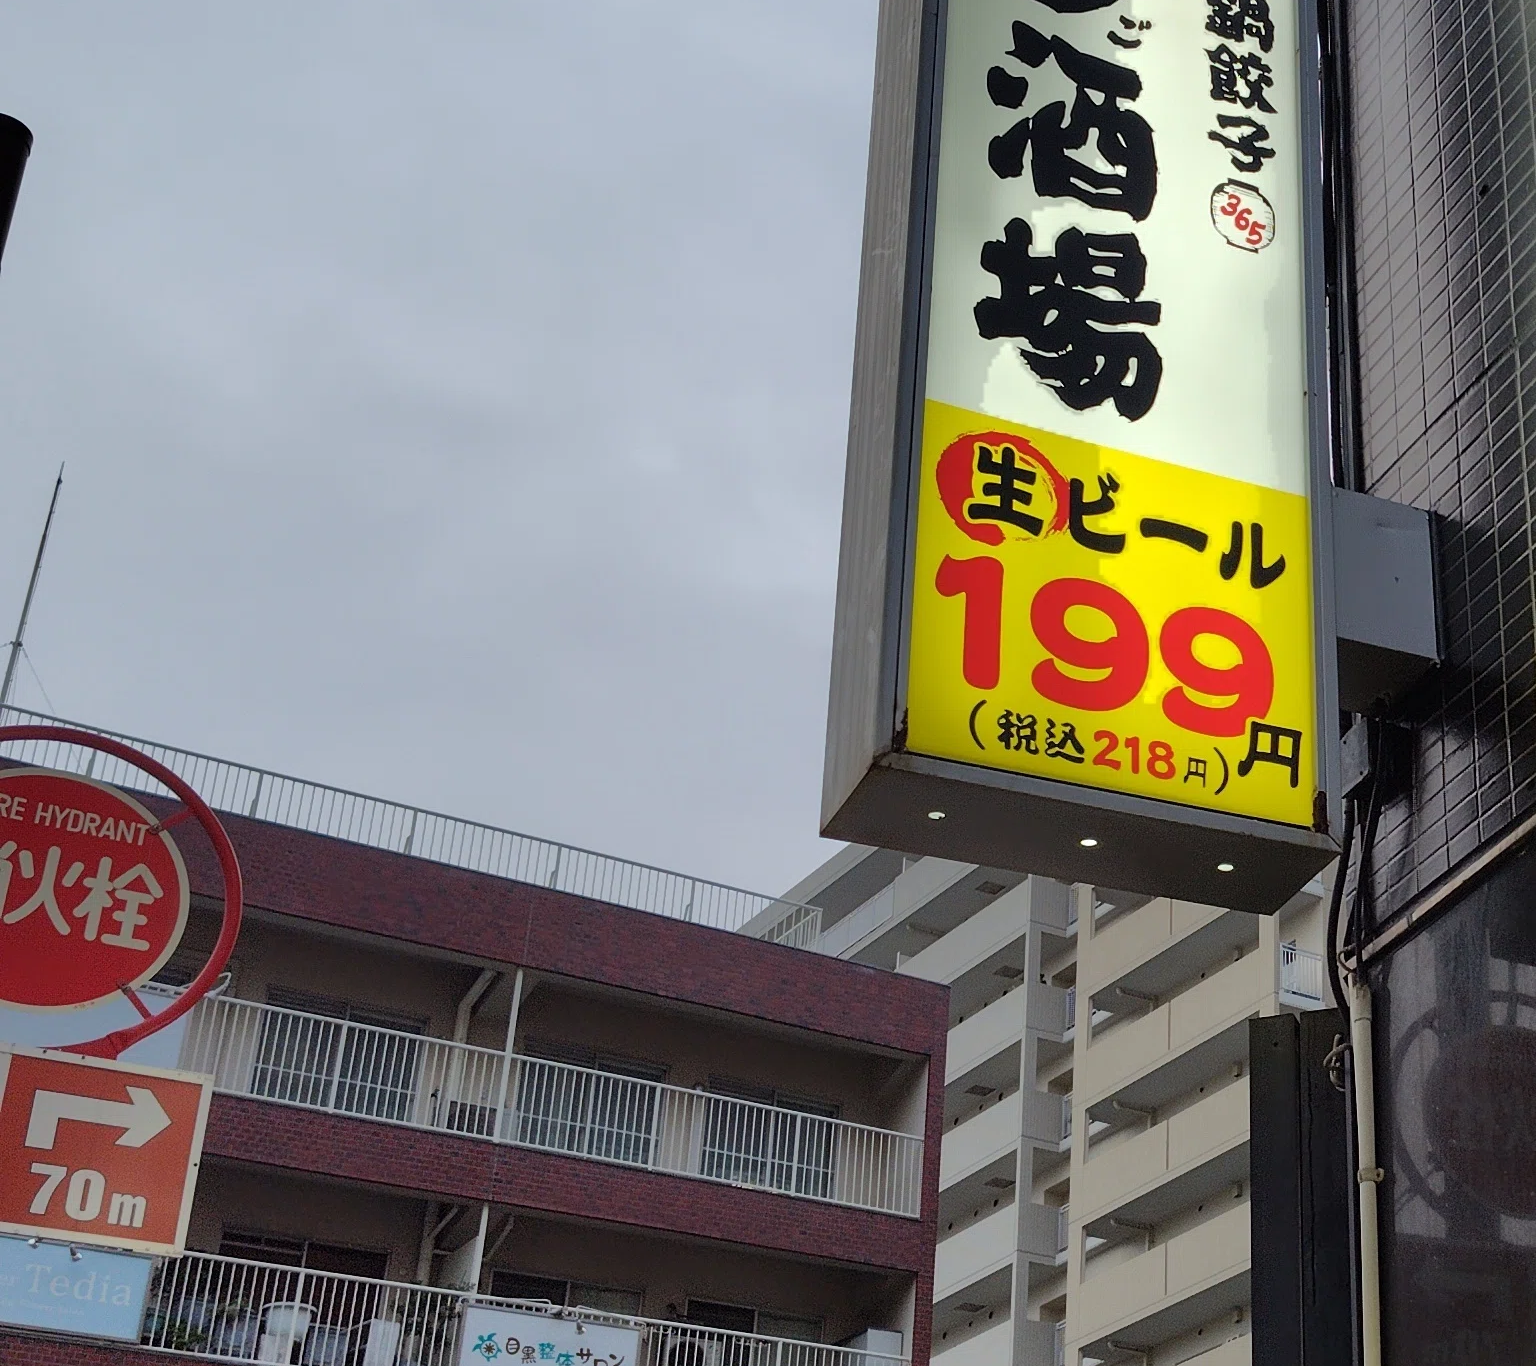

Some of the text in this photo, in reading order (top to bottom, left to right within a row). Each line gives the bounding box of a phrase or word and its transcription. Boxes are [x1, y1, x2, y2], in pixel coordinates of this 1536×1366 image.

[1220, 193, 1265, 246] 365
[967, 445, 1287, 589] 生ビール
[34, 802, 150, 846] HYDRANT
[0, 841, 164, 951] 火栓
[30, 1162, 148, 1229] 70m
[25, 1264, 132, 1306] Tedia
